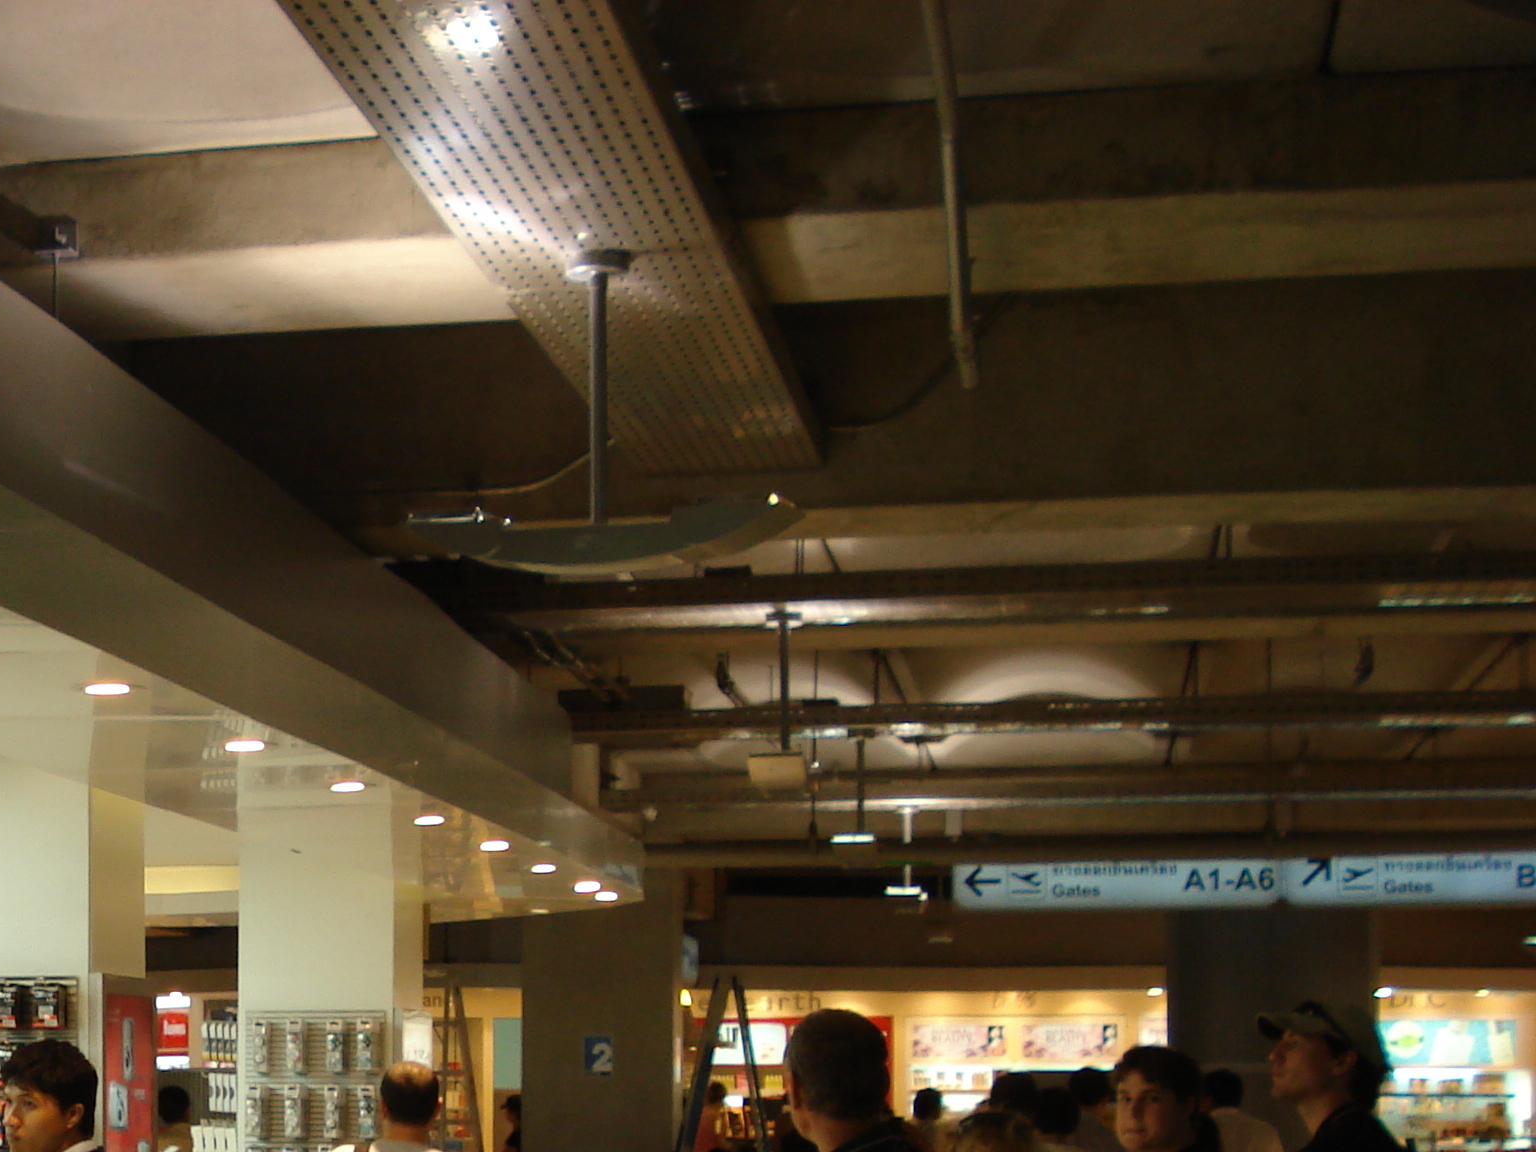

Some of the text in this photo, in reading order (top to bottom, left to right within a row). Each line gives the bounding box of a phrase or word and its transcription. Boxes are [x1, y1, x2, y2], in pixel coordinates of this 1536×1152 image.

[1183, 867, 1275, 891] A1-A6
[1383, 879, 1435, 895] Gates
[1052, 882, 1101, 898] Gates
[591, 1042, 614, 1074] 2
